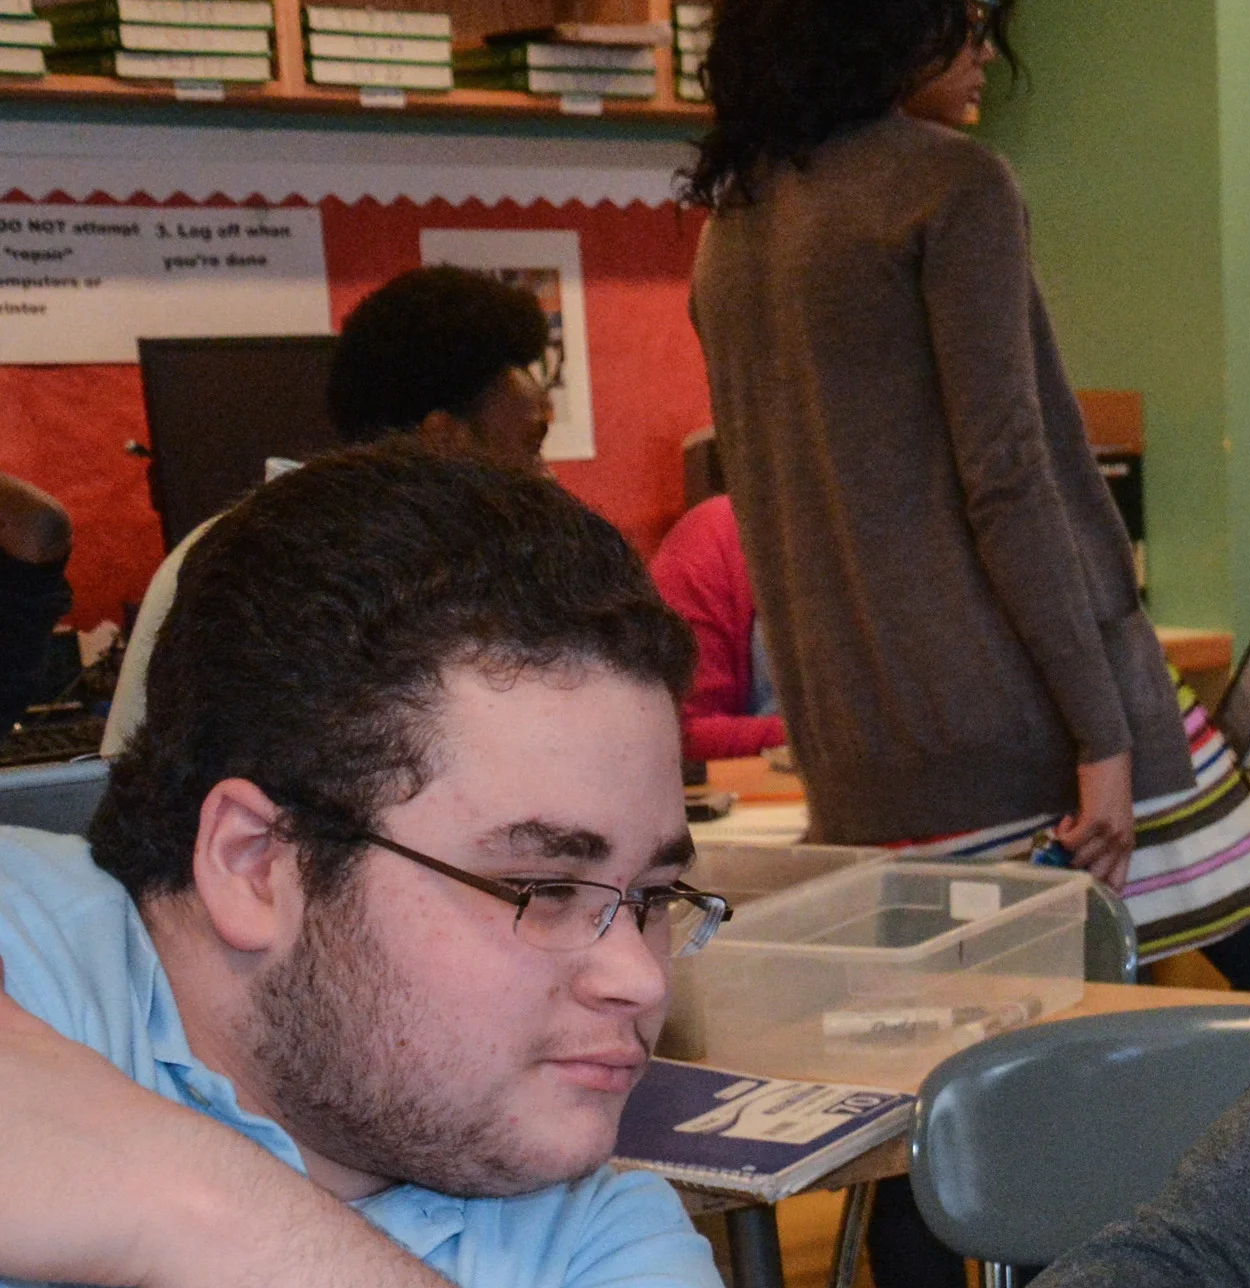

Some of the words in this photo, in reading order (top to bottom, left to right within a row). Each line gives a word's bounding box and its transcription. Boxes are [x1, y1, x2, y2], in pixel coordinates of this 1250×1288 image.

[27, 218, 66, 234] NOT
[72, 221, 140, 237] attempt
[177, 223, 213, 243] Log
[218, 223, 240, 238] off
[246, 224, 291, 239] when
[226, 253, 267, 268] done
